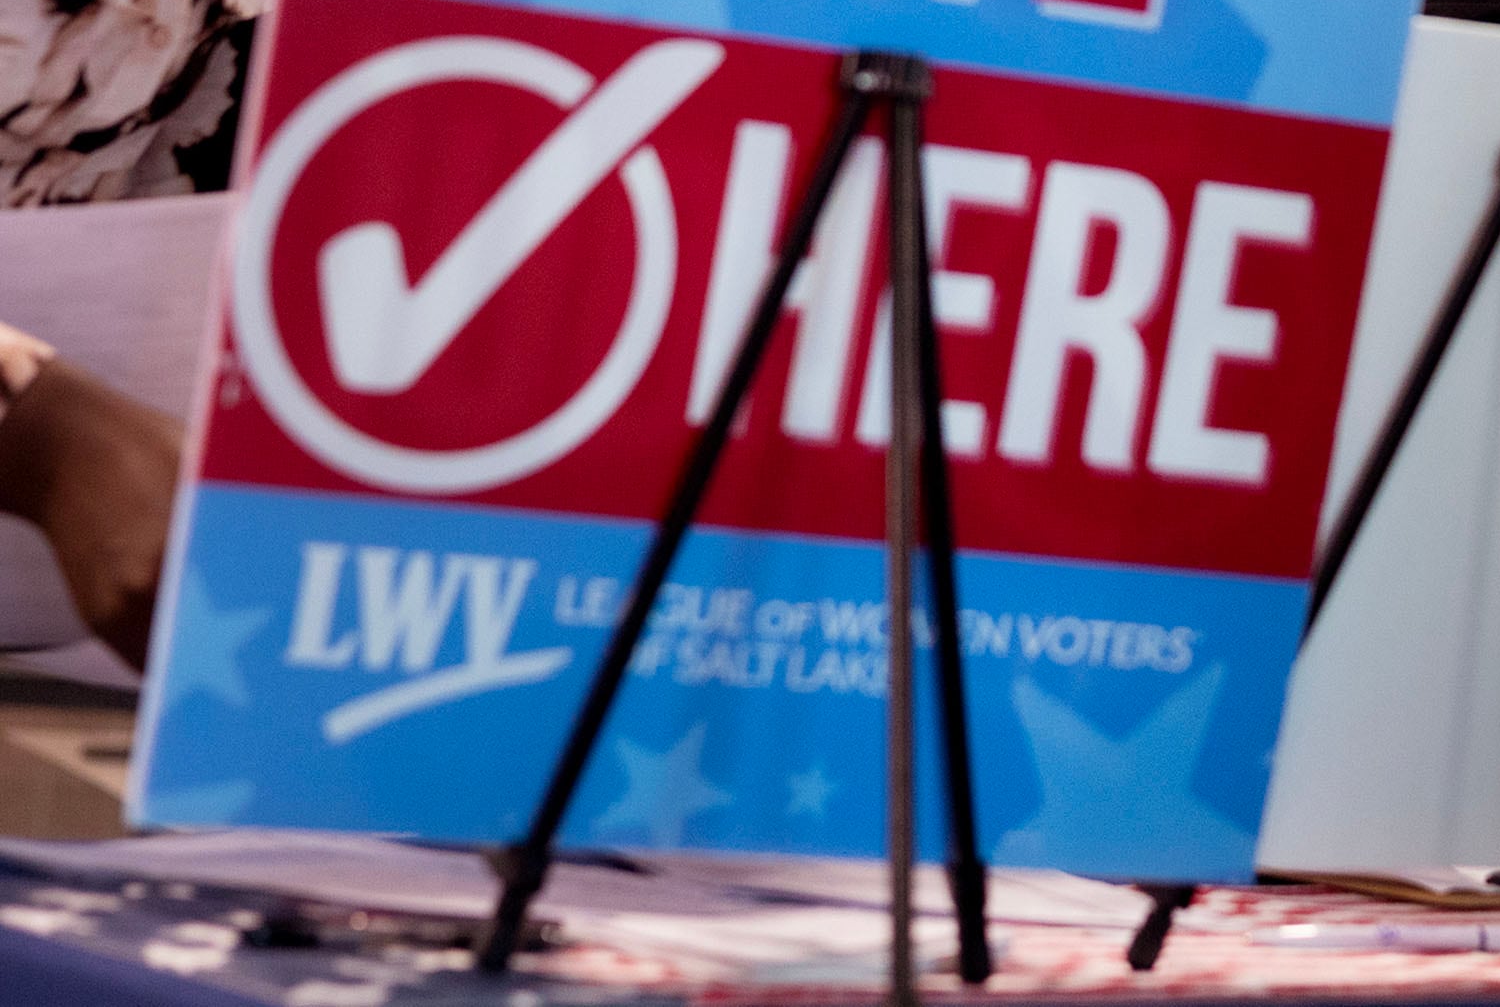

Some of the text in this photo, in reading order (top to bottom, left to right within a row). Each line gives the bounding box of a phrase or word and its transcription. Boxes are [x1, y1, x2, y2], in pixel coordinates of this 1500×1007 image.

[282, 541, 540, 676] LWV
[554, 573, 753, 638] LEGUE
[1016, 613, 1196, 674] VOTERS
[671, 637, 786, 688] SALT
